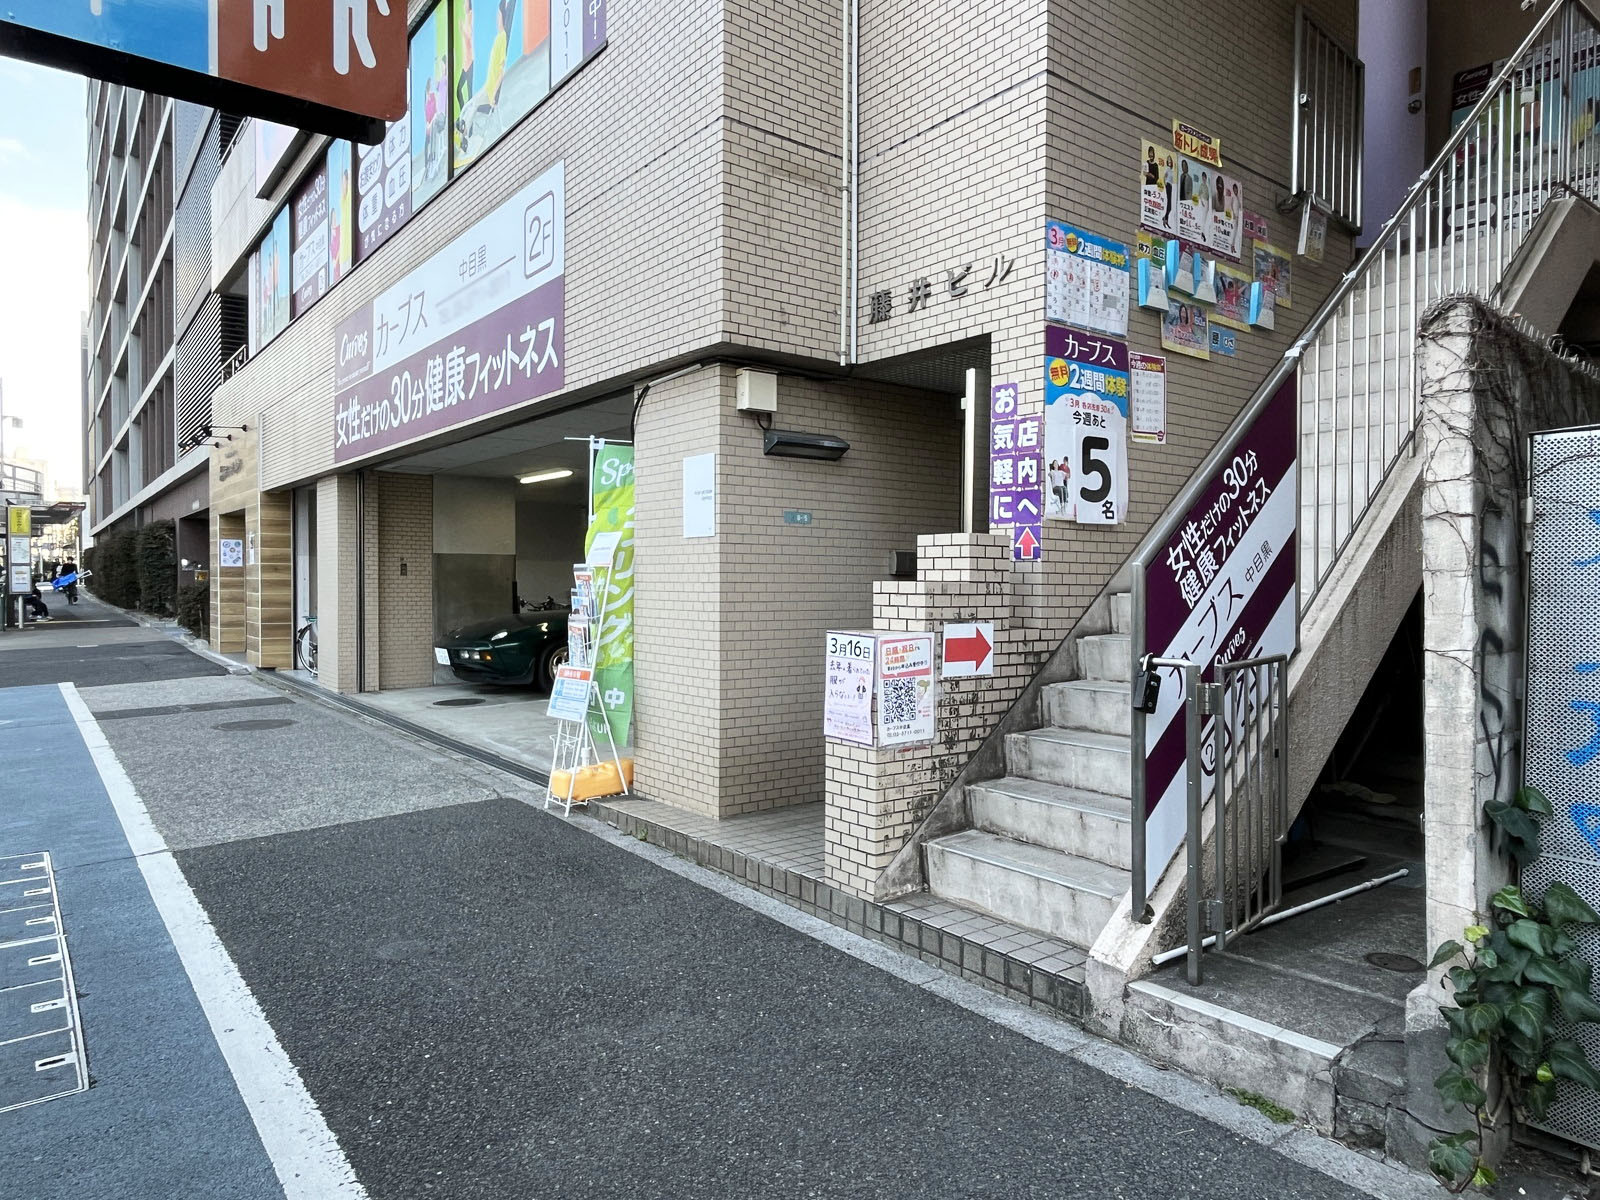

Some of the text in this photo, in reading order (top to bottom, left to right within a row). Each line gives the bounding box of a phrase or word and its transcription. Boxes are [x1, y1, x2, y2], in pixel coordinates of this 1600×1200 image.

[528, 215, 553, 262] 2F
[458, 244, 488, 283] 中目黒
[869, 254, 1016, 324] 藤井ビル
[376, 291, 428, 359] カーブス
[340, 330, 368, 367] Curves
[1064, 334, 1116, 366] カーブス
[336, 317, 558, 449] 女性だけの30分健康フィットネス
[1049, 364, 1127, 398] 無料 2週間体験
[1073, 410, 1106, 428] 今週あと
[600, 458, 634, 488] Sp
[993, 388, 1015, 520] お気軽に
[1017, 420, 1039, 516] 店内へ
[1080, 435, 1112, 502] 5
[1101, 500, 1115, 520] 名
[1166, 449, 1259, 582] 女性だけの30分
[1181, 477, 1271, 610] 健康フィットネス
[1245, 541, 1274, 584] 中目黒
[830, 637, 871, 659] 3月16日
